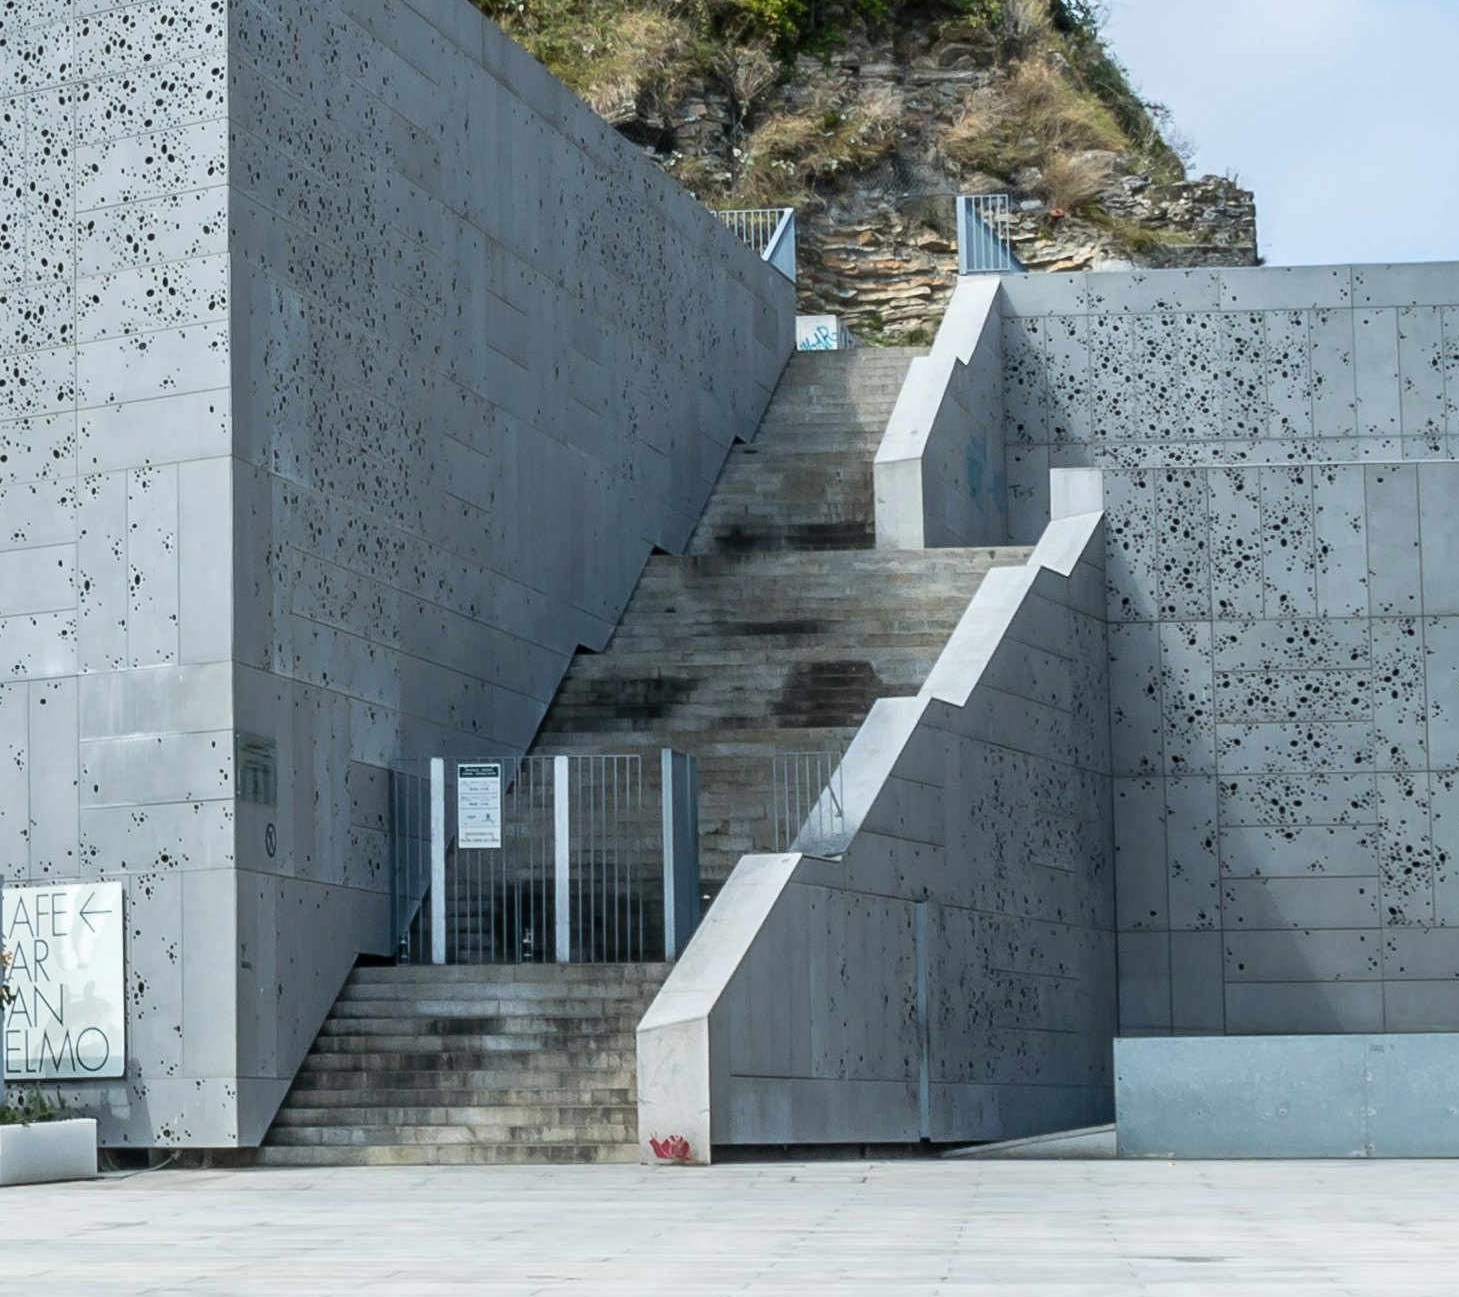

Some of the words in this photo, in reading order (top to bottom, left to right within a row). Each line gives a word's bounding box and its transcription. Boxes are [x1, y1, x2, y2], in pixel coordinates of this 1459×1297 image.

[9, 893, 68, 939] AFE
[8, 939, 50, 983] AR
[7, 983, 64, 1027] AN
[6, 1027, 109, 1073] ELMO
